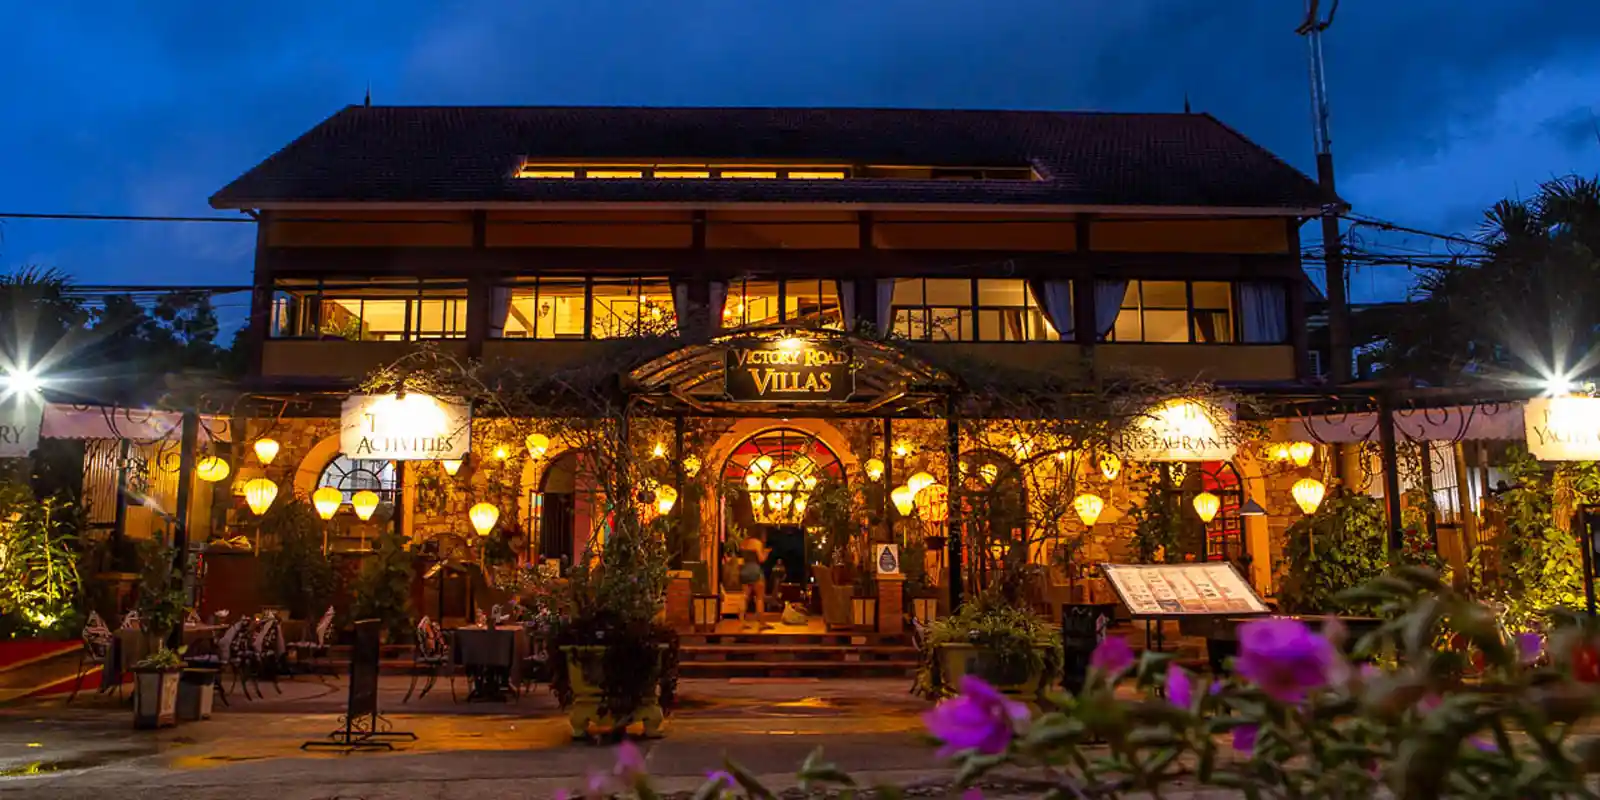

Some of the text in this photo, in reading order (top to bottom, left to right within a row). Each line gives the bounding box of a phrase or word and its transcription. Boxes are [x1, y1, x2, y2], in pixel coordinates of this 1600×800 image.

[734, 348, 849, 367] VICTORY ROAD
[747, 367, 832, 396] VILLAS
[356, 436, 454, 454] ACTIVITIES
[1119, 433, 1233, 453] RESTAURANT
